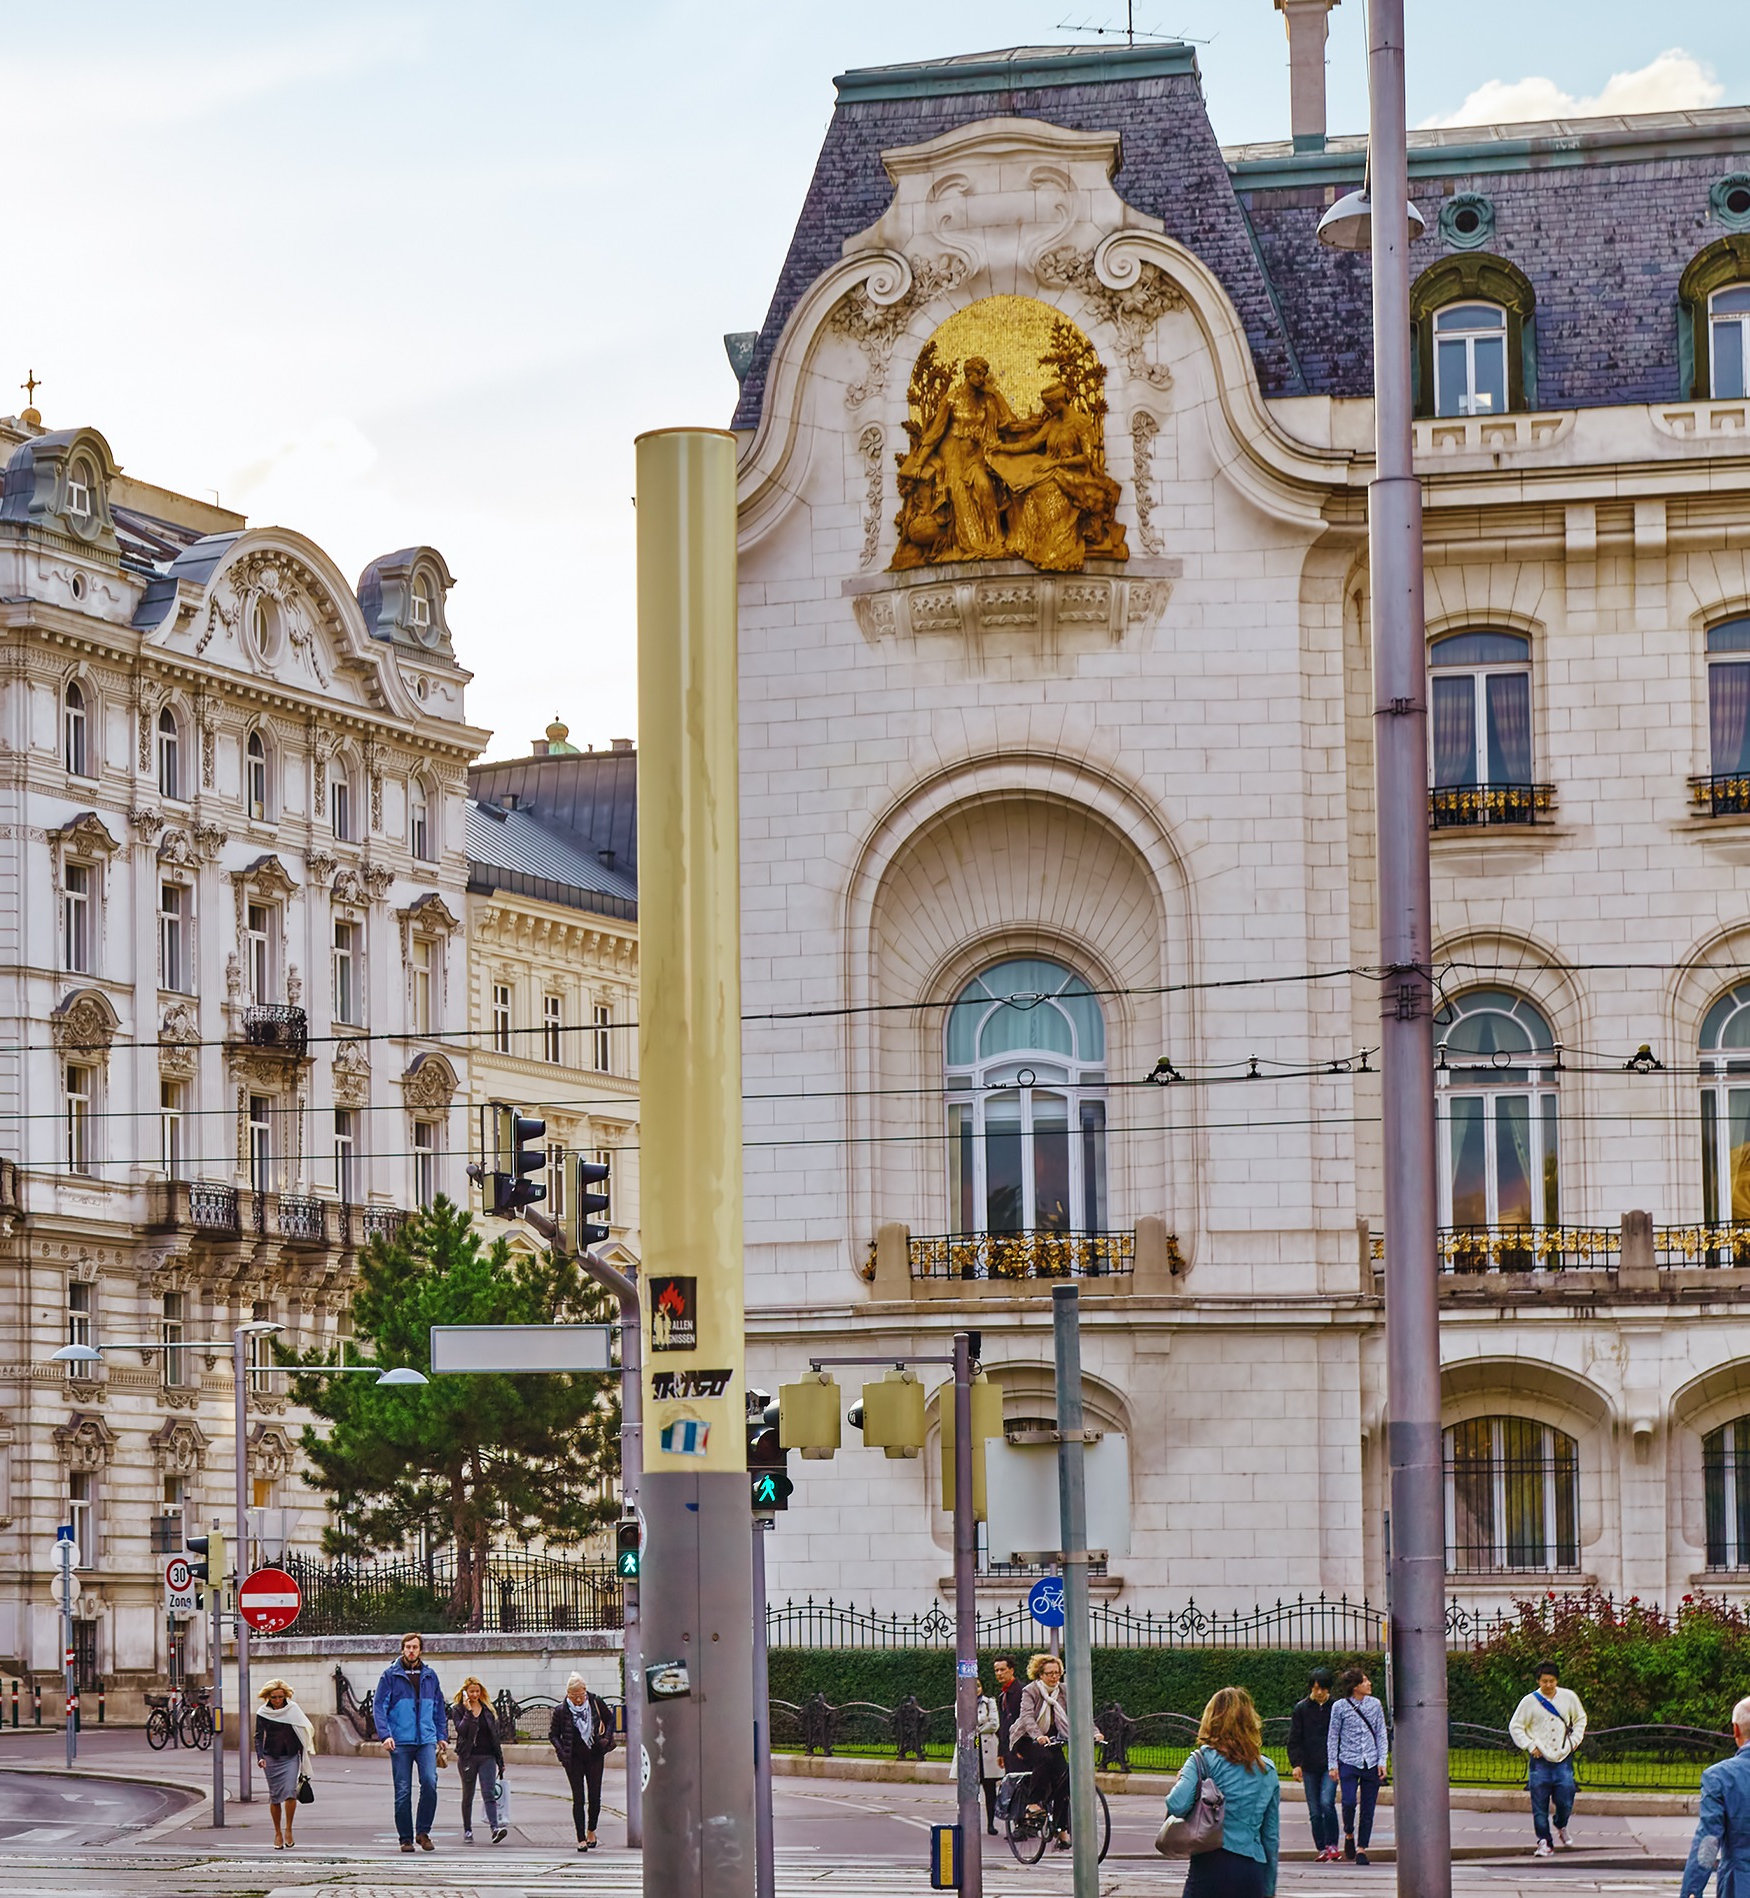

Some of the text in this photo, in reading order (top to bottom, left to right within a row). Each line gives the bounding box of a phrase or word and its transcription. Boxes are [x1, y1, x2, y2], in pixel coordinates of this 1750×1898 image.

[672, 1320, 693, 1330] ALLEN
[173, 1567, 185, 1582] 30
[170, 1594, 191, 1608] Zone
